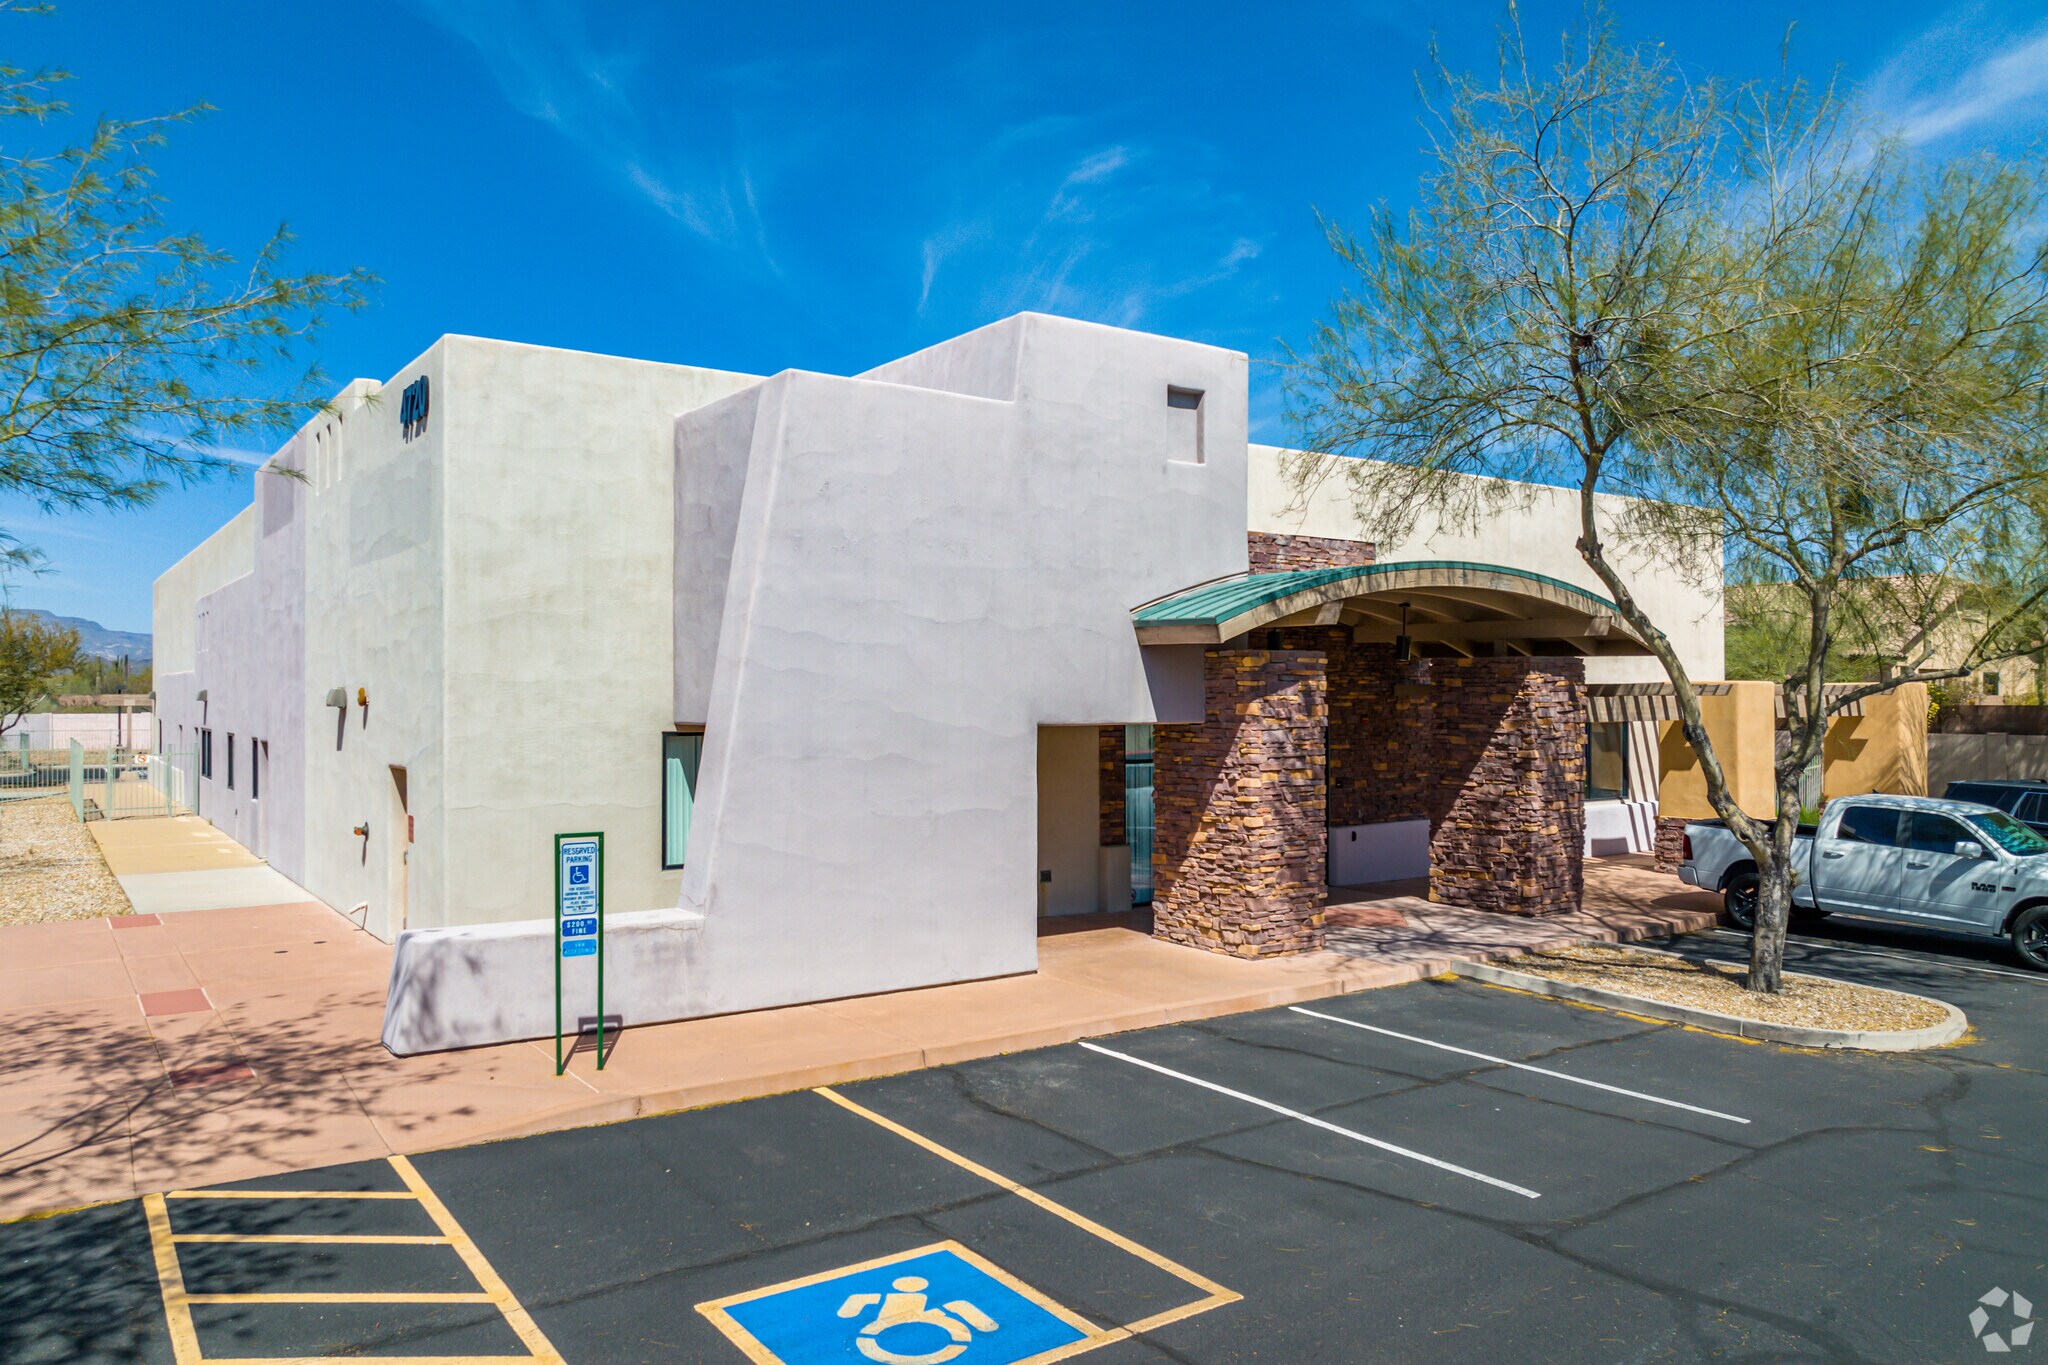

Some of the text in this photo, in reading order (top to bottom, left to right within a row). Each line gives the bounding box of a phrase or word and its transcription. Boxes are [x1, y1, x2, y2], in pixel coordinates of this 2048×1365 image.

[563, 847, 595, 855] RESERVED
[566, 855, 592, 863] PARKING
[572, 927, 587, 935] FINE
